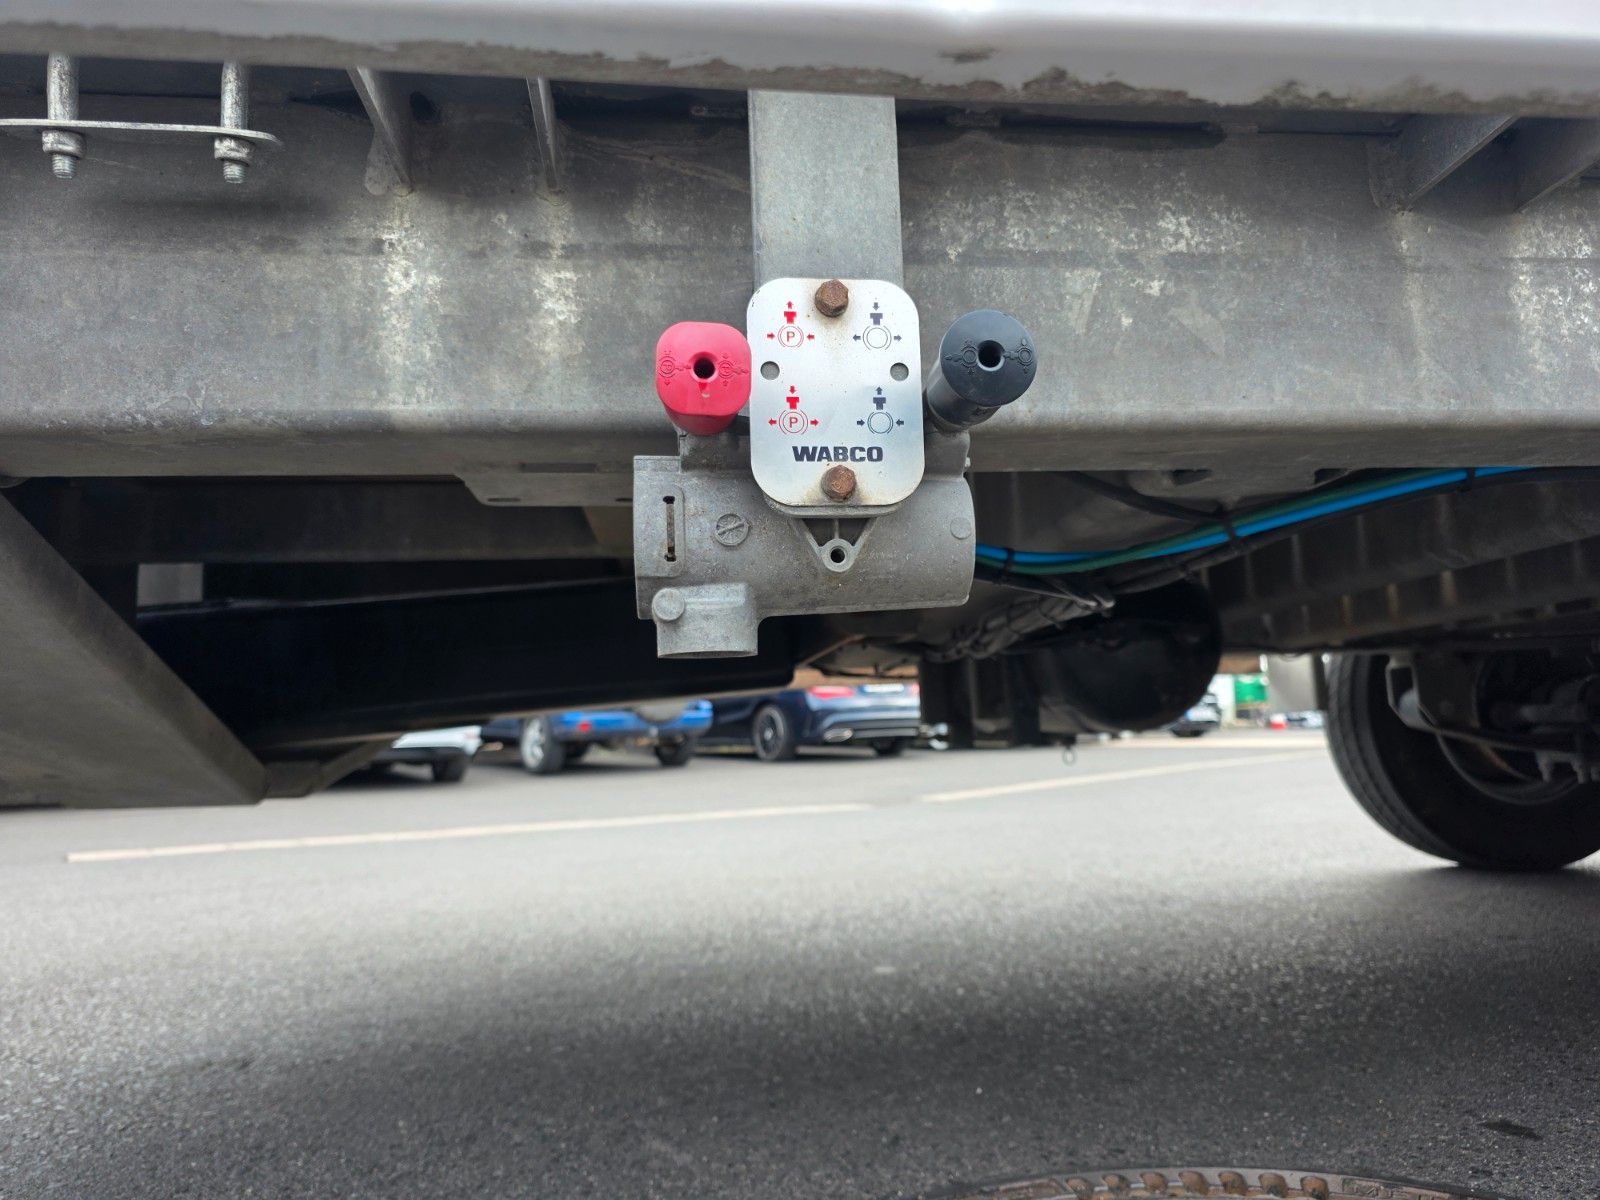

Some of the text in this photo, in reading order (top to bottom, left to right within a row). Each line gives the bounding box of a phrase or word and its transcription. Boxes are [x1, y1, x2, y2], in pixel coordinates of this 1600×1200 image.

[786, 331, 795, 342] P
[789, 416, 798, 428] P
[791, 446, 884, 462] WABCO
